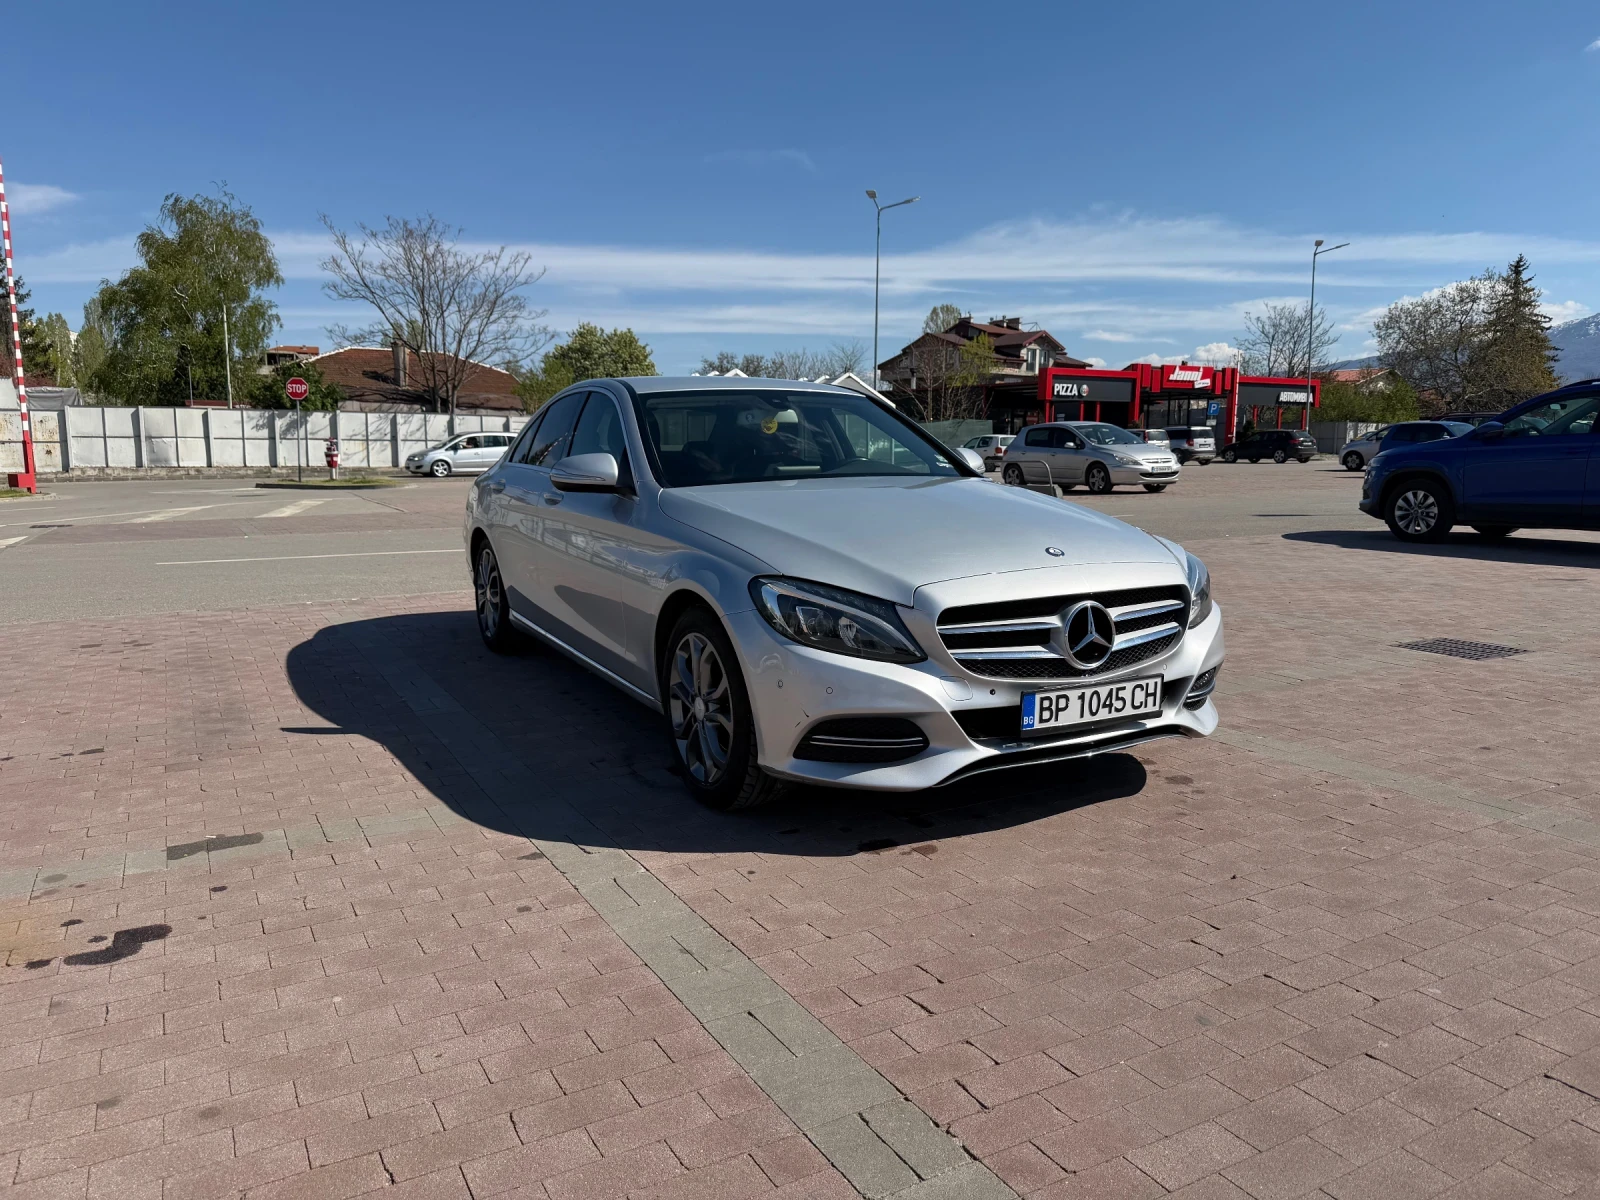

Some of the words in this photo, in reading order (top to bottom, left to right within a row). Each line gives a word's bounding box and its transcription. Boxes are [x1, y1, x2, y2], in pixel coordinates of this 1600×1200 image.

[287, 384, 307, 393] STOP
[1054, 383, 1078, 396] PIZZA
[1038, 693, 1070, 724] BP
[1077, 686, 1127, 719] 1045
[1131, 681, 1158, 710] CH
[1023, 716, 1034, 725] BG
